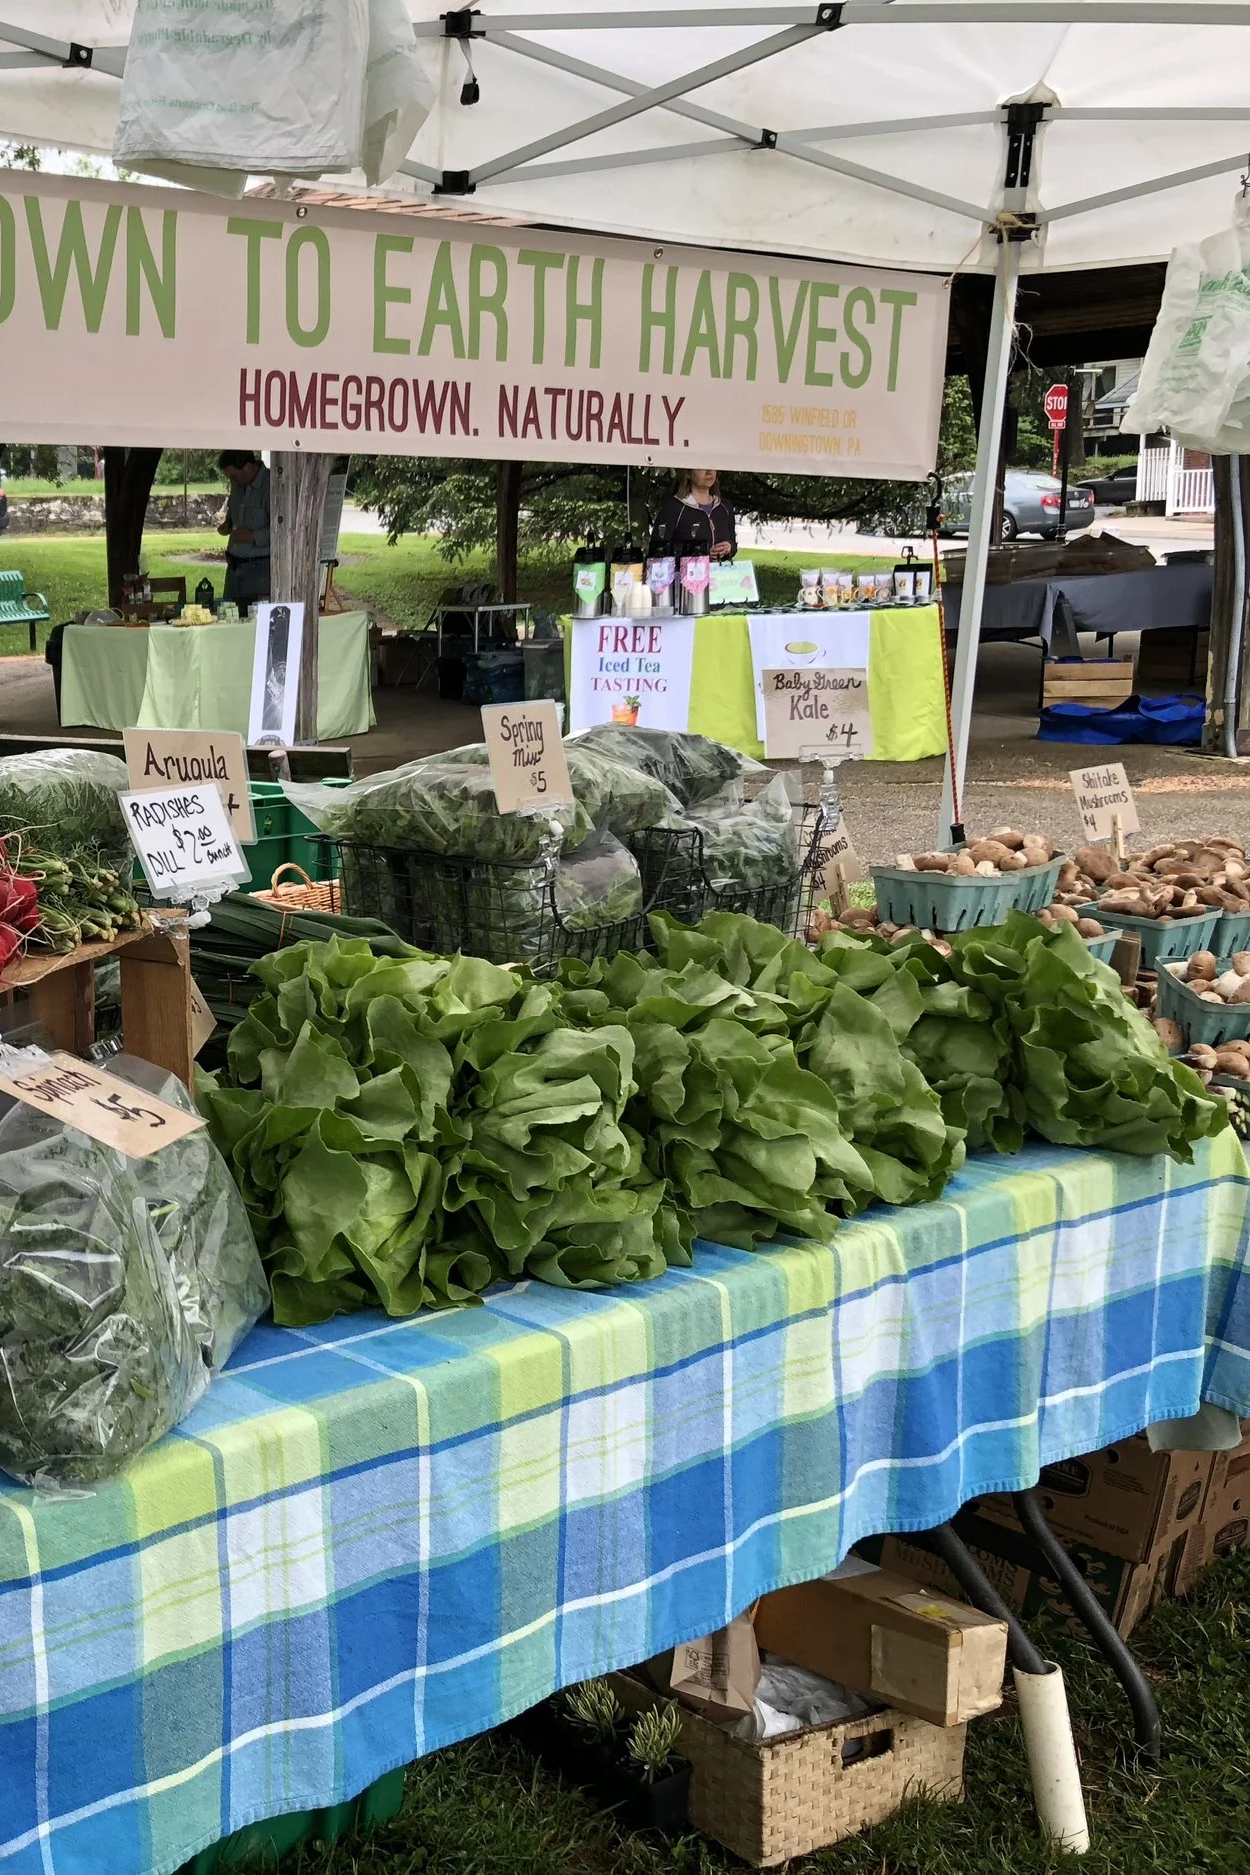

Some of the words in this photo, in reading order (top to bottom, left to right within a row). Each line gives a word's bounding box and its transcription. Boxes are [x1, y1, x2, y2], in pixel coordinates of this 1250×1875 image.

[227, 216, 331, 348] TO
[373, 233, 606, 369] EARTH
[639, 263, 918, 393] HARVEST
[239, 367, 479, 437] HOMEGROWN.
[498, 383, 689, 447] NATURALLY.
[790, 406, 839, 428] WINFIELD
[842, 409, 857, 429] DR
[846, 437, 861, 456] PA
[598, 625, 662, 653] FREE
[599, 657, 630, 673] Iced
[635, 657, 661, 673] Tea
[590, 677, 668, 693] TASTING
[772, 671, 812, 701] Baby
[813, 671, 862, 691] Green
[790, 694, 830, 720] Kale
[500, 714, 545, 756] Spring
[826, 722, 858, 747] $4
[512, 745, 542, 767] Mix
[530, 770, 547, 793] $5
[1081, 768, 1120, 789] Shitake
[129, 794, 205, 831] RADISHES
[1078, 790, 1129, 811] Mushrooms
[1083, 813, 1097, 832] $4
[147, 850, 186, 878] DILL
[11, 1065, 102, 1106] Spinach
[89, 1092, 166, 1128] $5
